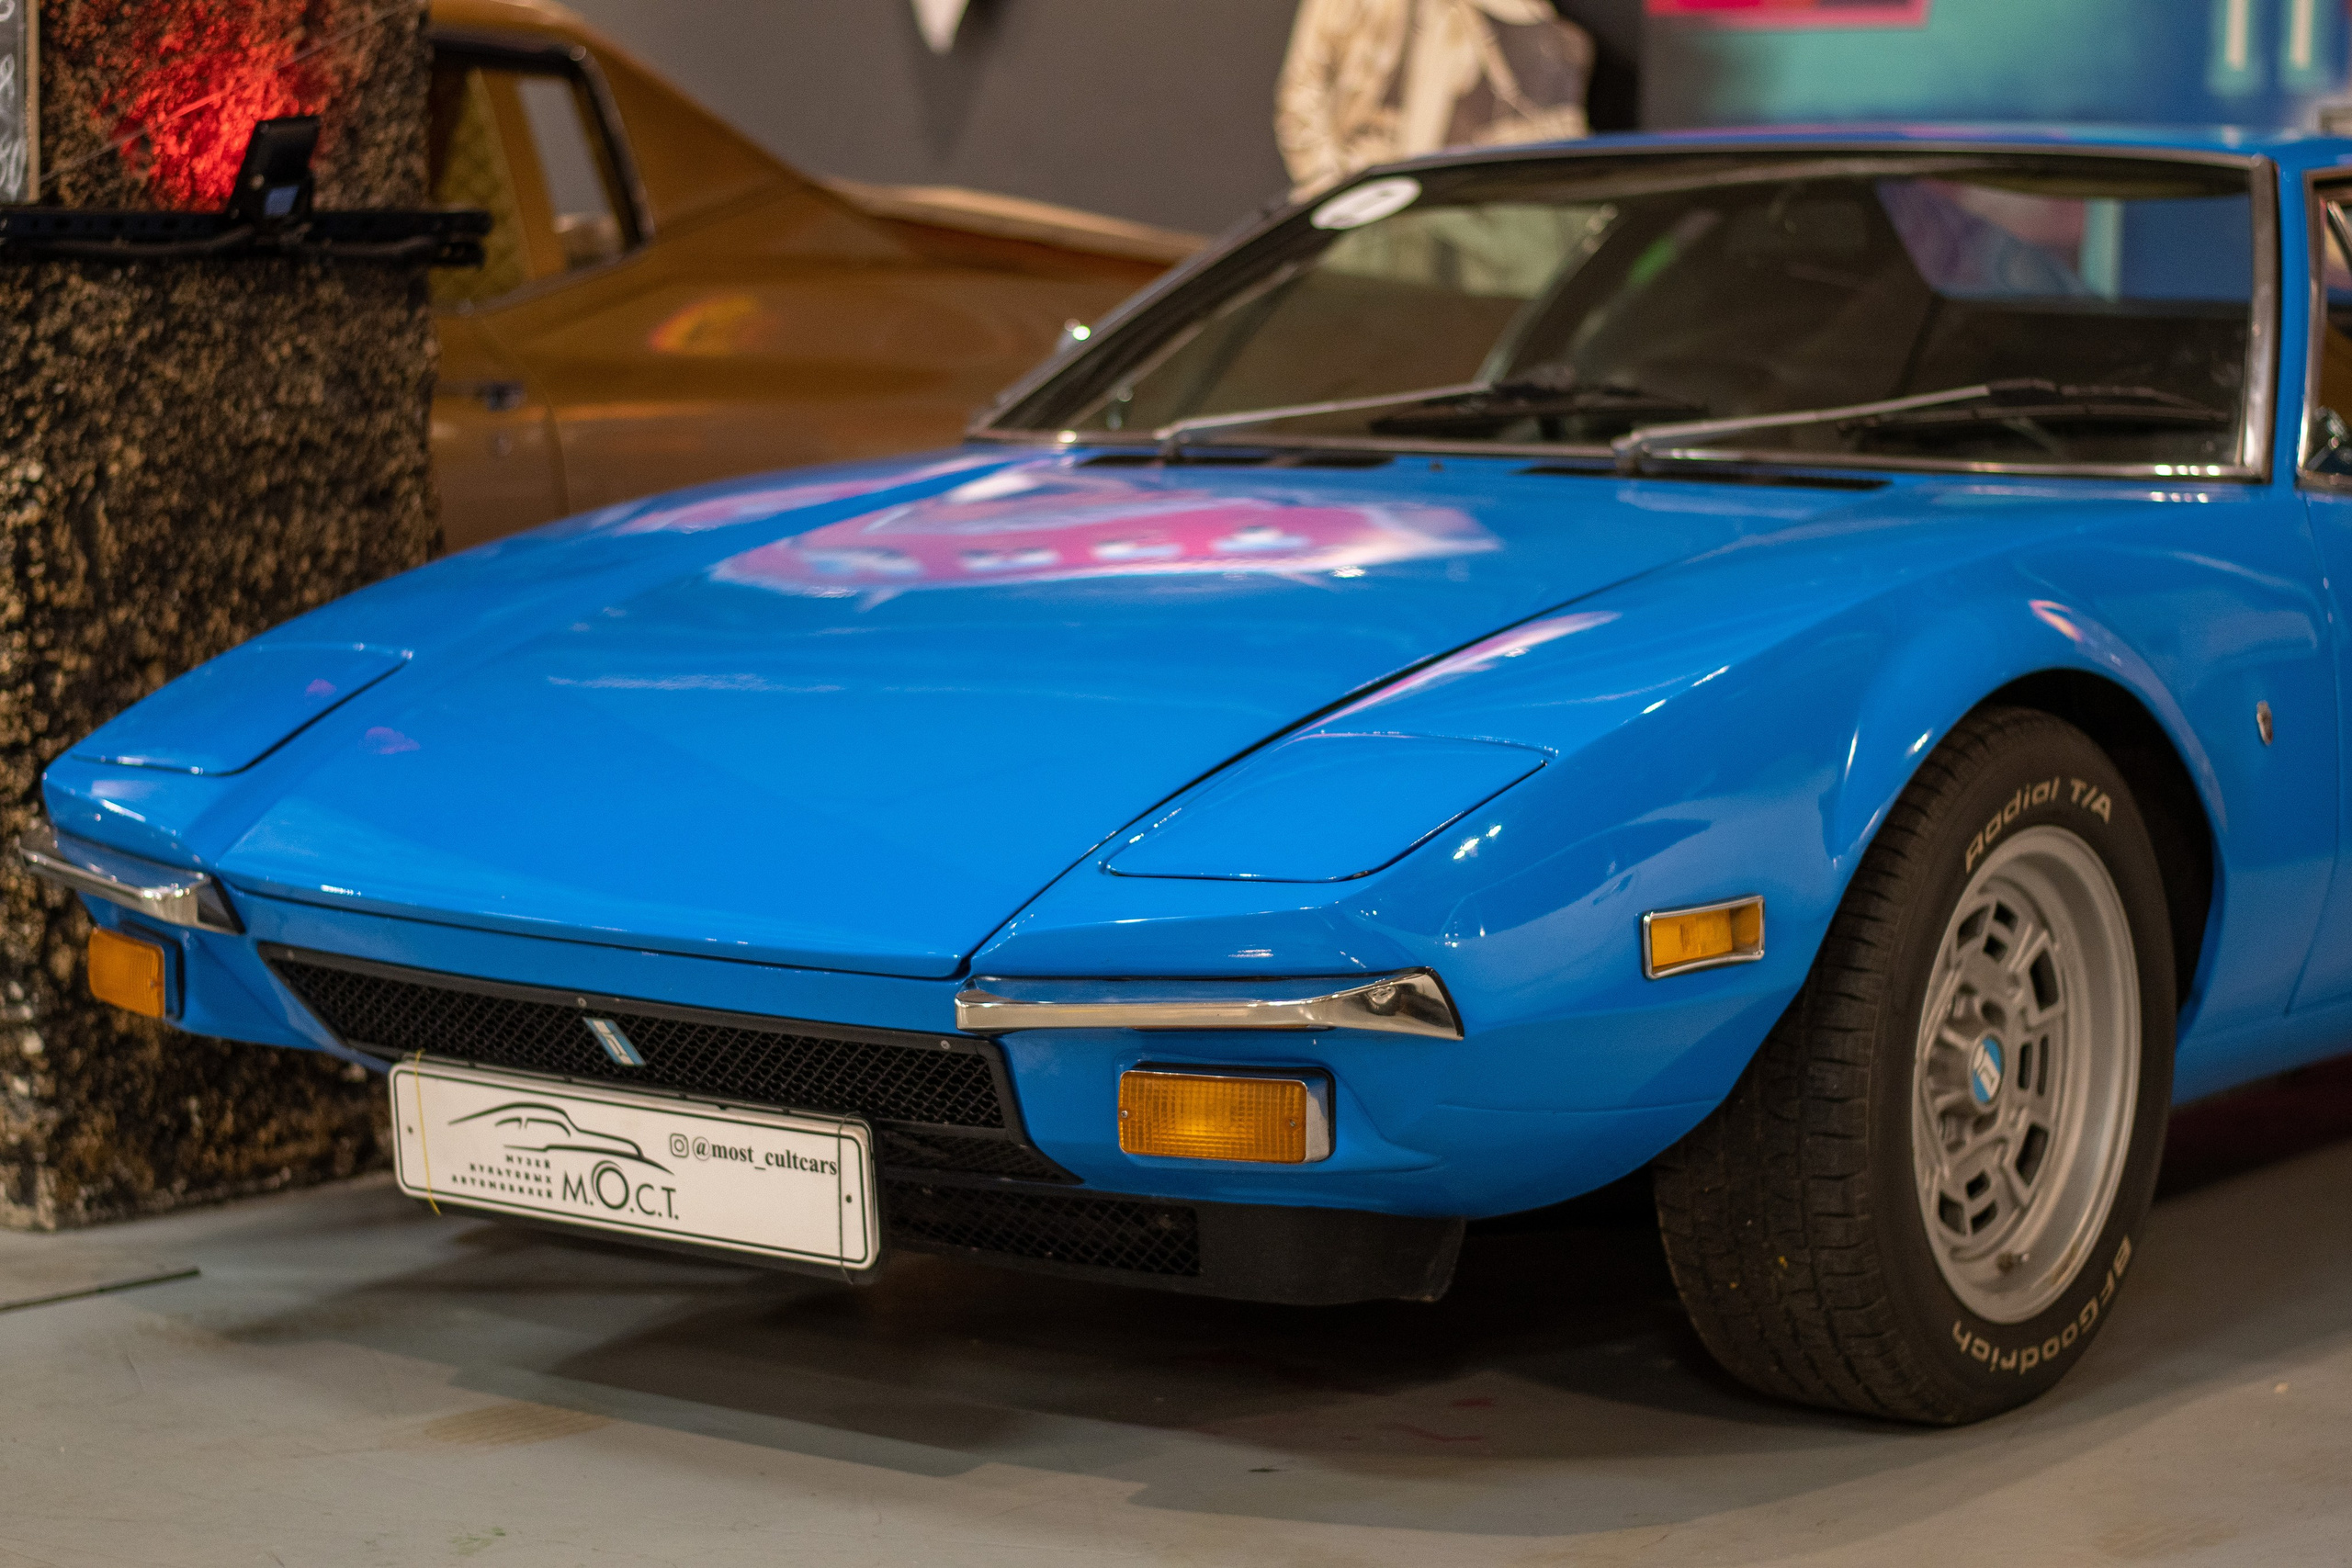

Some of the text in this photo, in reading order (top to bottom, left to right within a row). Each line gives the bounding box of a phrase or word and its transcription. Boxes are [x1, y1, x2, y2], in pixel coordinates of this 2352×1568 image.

[1965, 776, 2112, 874] Radial T/A
[693, 1136, 838, 1176] @most_cultcars
